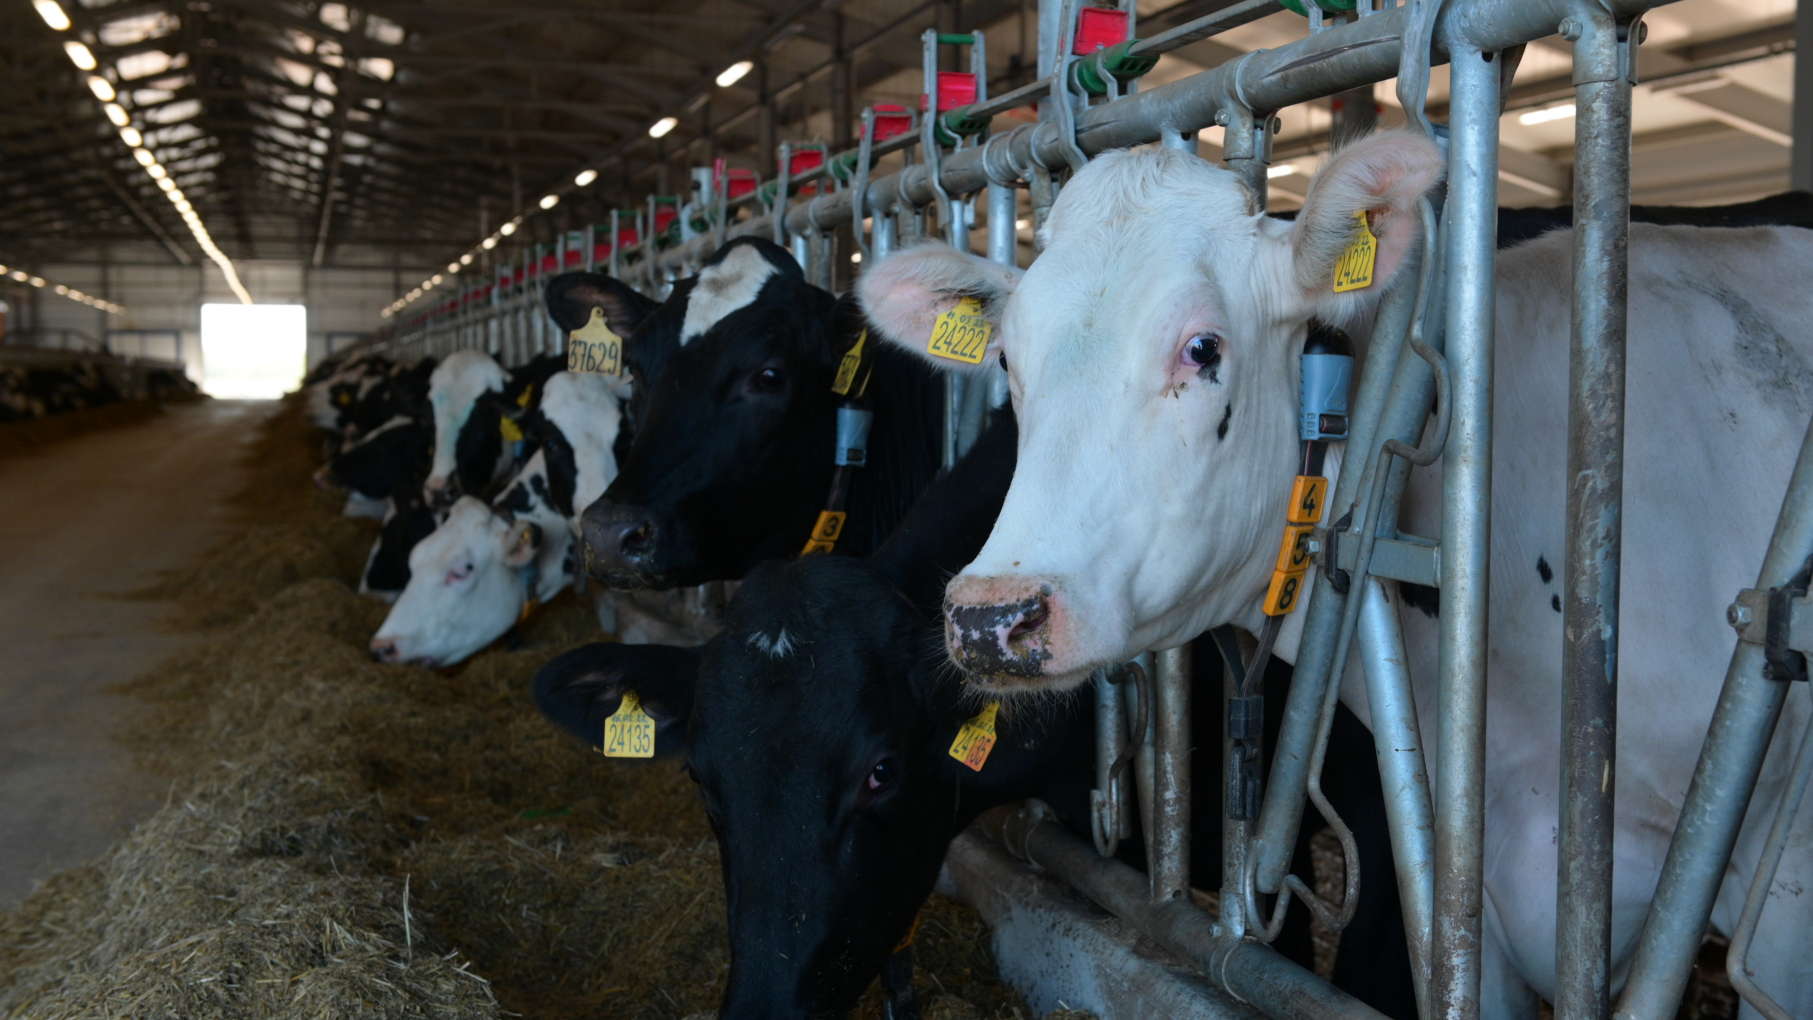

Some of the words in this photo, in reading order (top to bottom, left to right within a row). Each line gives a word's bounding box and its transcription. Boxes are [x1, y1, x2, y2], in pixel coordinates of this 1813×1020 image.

[1337, 246, 1371, 287] 24222
[568, 339, 618, 375] 37629
[932, 321, 986, 359] 24222
[1302, 483, 1316, 517] 4
[823, 516, 839, 537] 3
[1279, 578, 1297, 609] 8
[609, 724, 651, 753] 24135
[953, 726, 992, 766] 24135
